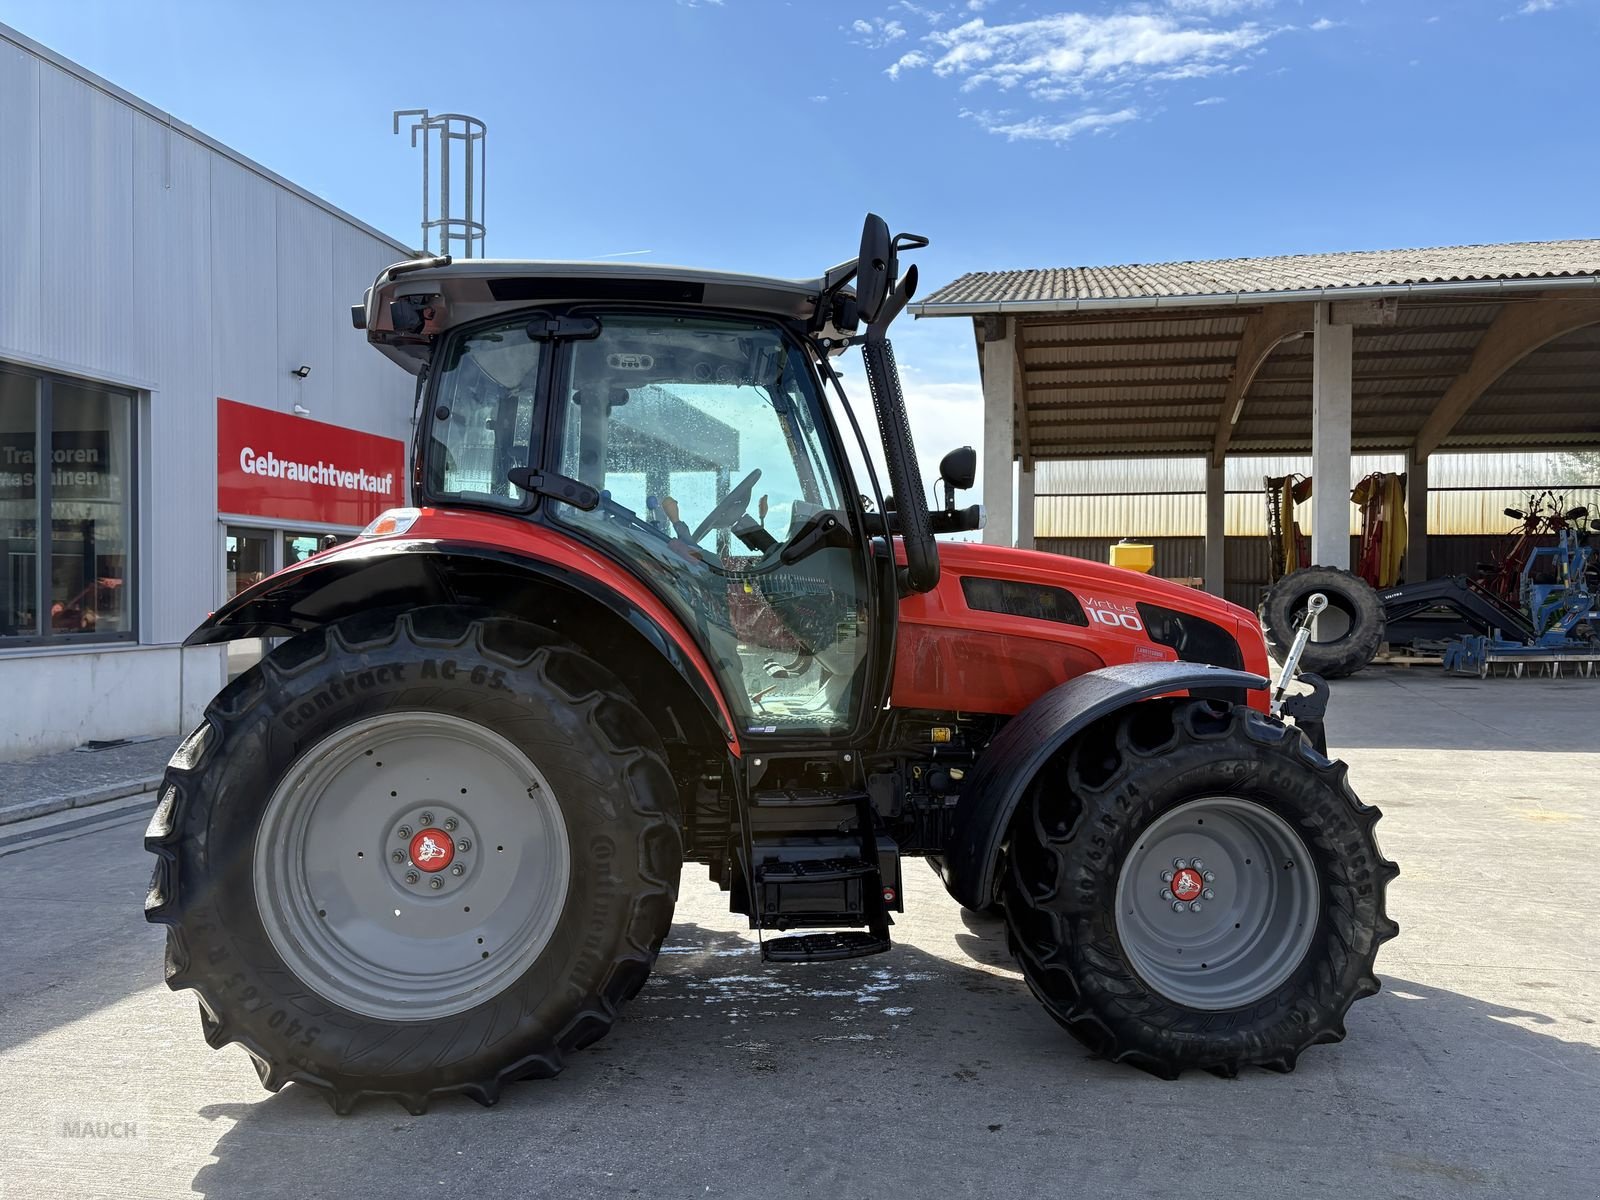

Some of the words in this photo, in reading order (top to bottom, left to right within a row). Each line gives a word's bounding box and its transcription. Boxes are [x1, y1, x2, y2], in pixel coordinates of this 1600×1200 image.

[3, 447, 99, 464] Traoren
[0, 468, 99, 487] masinen
[240, 447, 392, 494] Gebrauchtverkauf
[1080, 595, 1136, 614] Virtus
[1085, 606, 1143, 631] 100
[420, 659, 457, 680] AC
[470, 665, 508, 690] 65
[1100, 813, 1119, 830] R
[1115, 782, 1141, 810] 24
[222, 971, 321, 1046] 540/65
